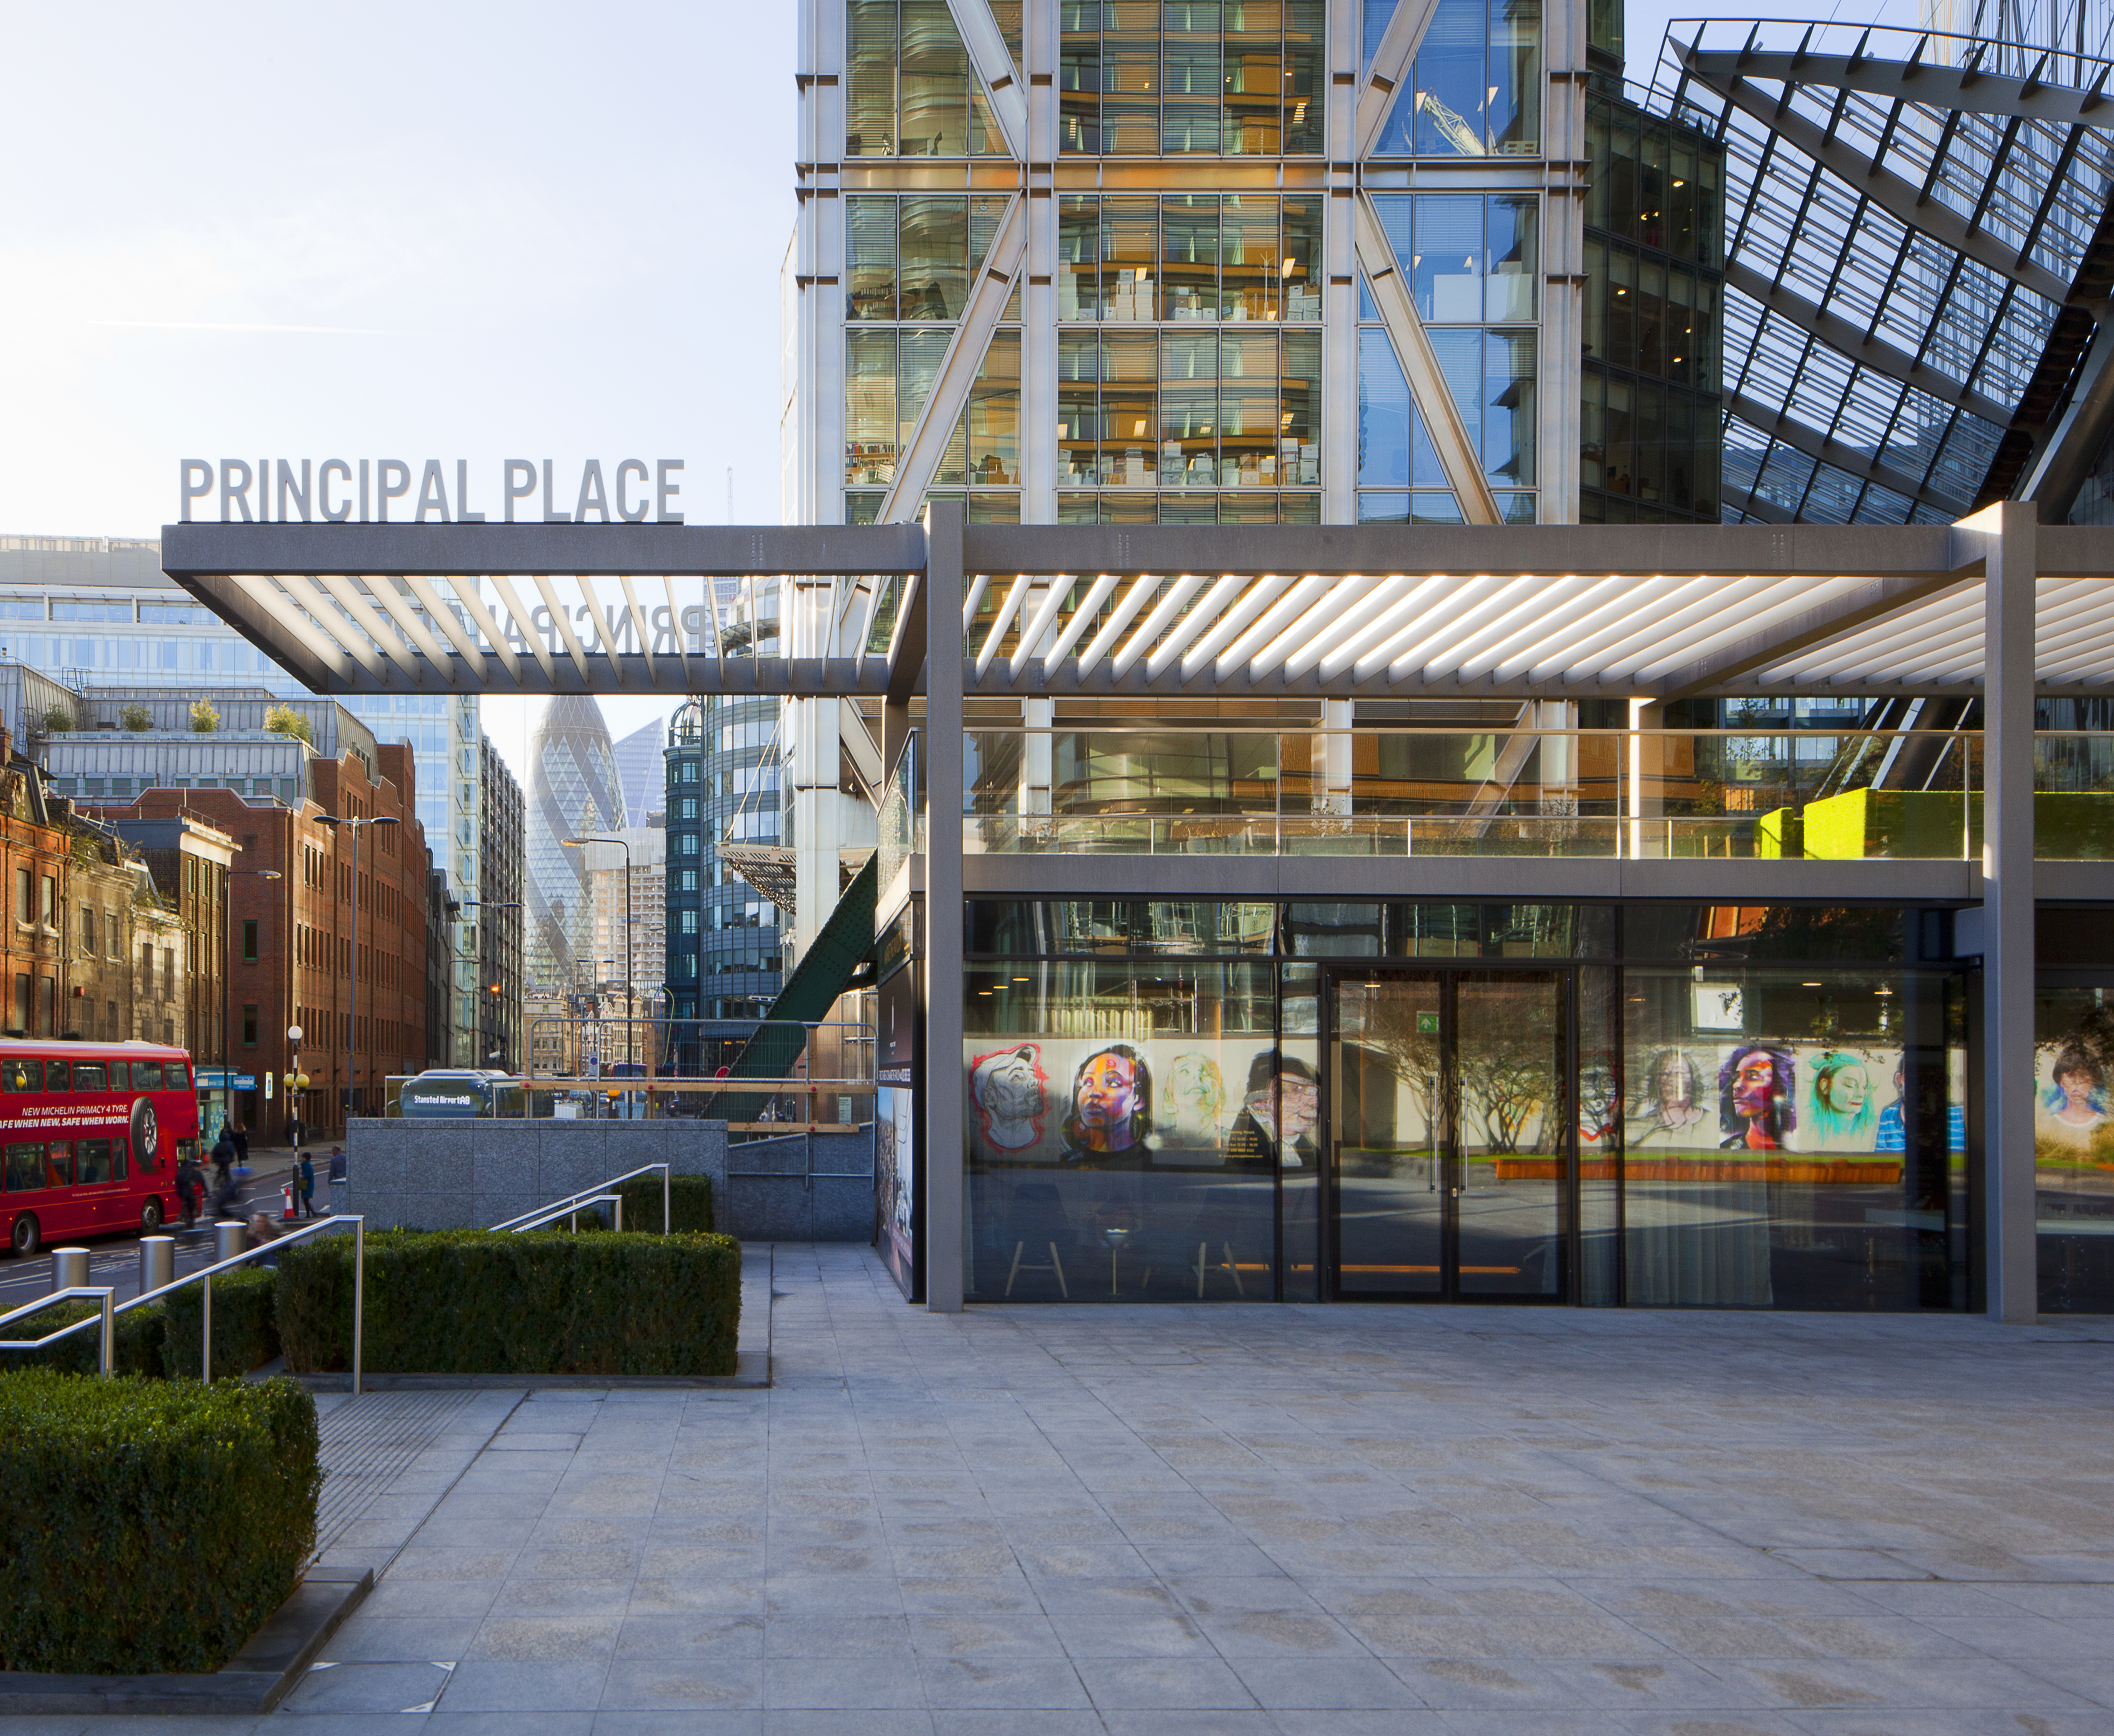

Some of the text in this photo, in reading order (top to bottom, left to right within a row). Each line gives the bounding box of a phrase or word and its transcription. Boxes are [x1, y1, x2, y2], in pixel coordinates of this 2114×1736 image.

[180, 458, 685, 522] PRINCIPAL PLACE
[414, 1095, 439, 1104] Stansted
[440, 1096, 460, 1104] Airport
[22, 1107, 40, 1116] NEW
[41, 1106, 75, 1115] MICHELIN
[76, 1105, 106, 1114] PRIMACY
[112, 1105, 128, 1113] TYRE.
[15, 1119, 39, 1128] WHEN
[40, 1118, 61, 1127] NEW,
[61, 1117, 80, 1126] SAFE
[81, 1117, 104, 1125] WHEN
